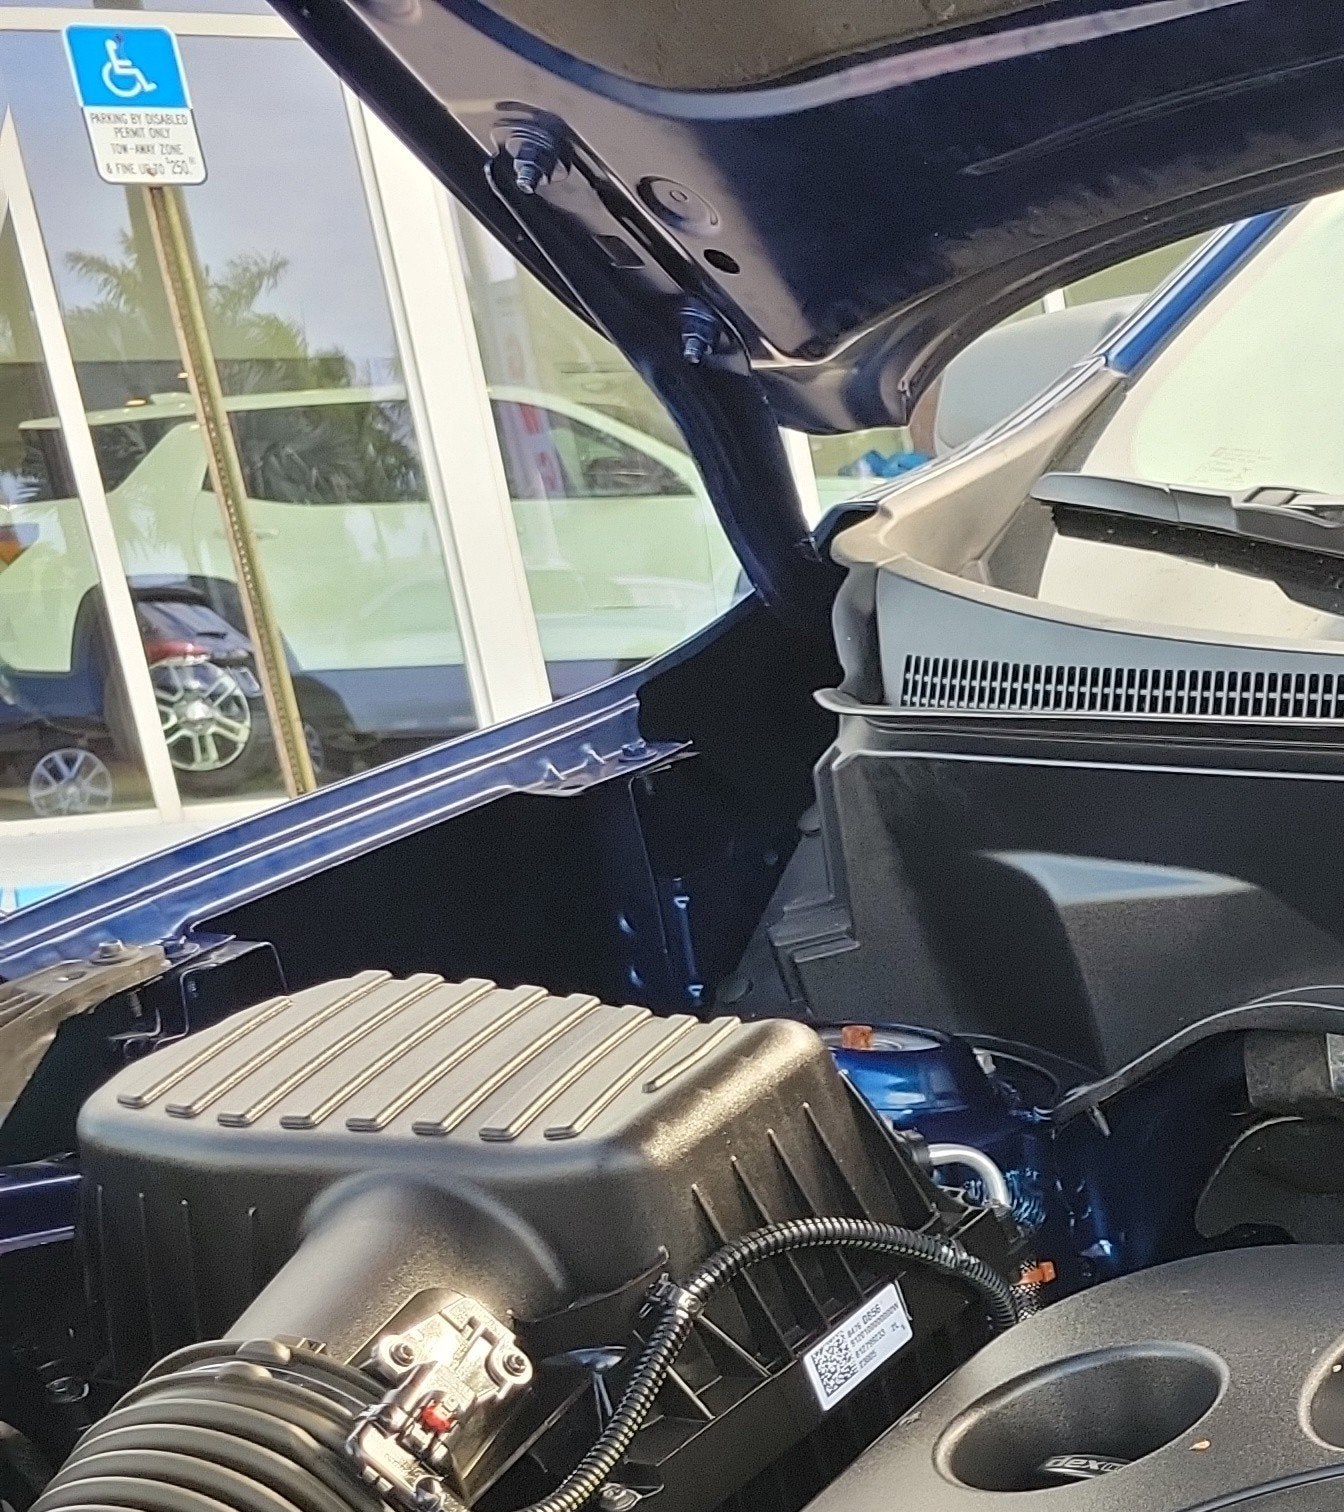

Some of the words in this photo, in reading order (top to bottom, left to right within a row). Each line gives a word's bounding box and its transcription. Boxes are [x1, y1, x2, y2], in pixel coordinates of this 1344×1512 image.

[90, 112, 128, 124] PARKING
[130, 113, 141, 124] BY
[144, 113, 188, 125] DISABLED
[114, 127, 145, 138] PERMIT
[149, 127, 170, 139] ONLY
[110, 143, 155, 155] TOW-AWAY
[160, 143, 183, 155] ZONE
[115, 163, 137, 174] FINE
[154, 163, 165, 175] TO
